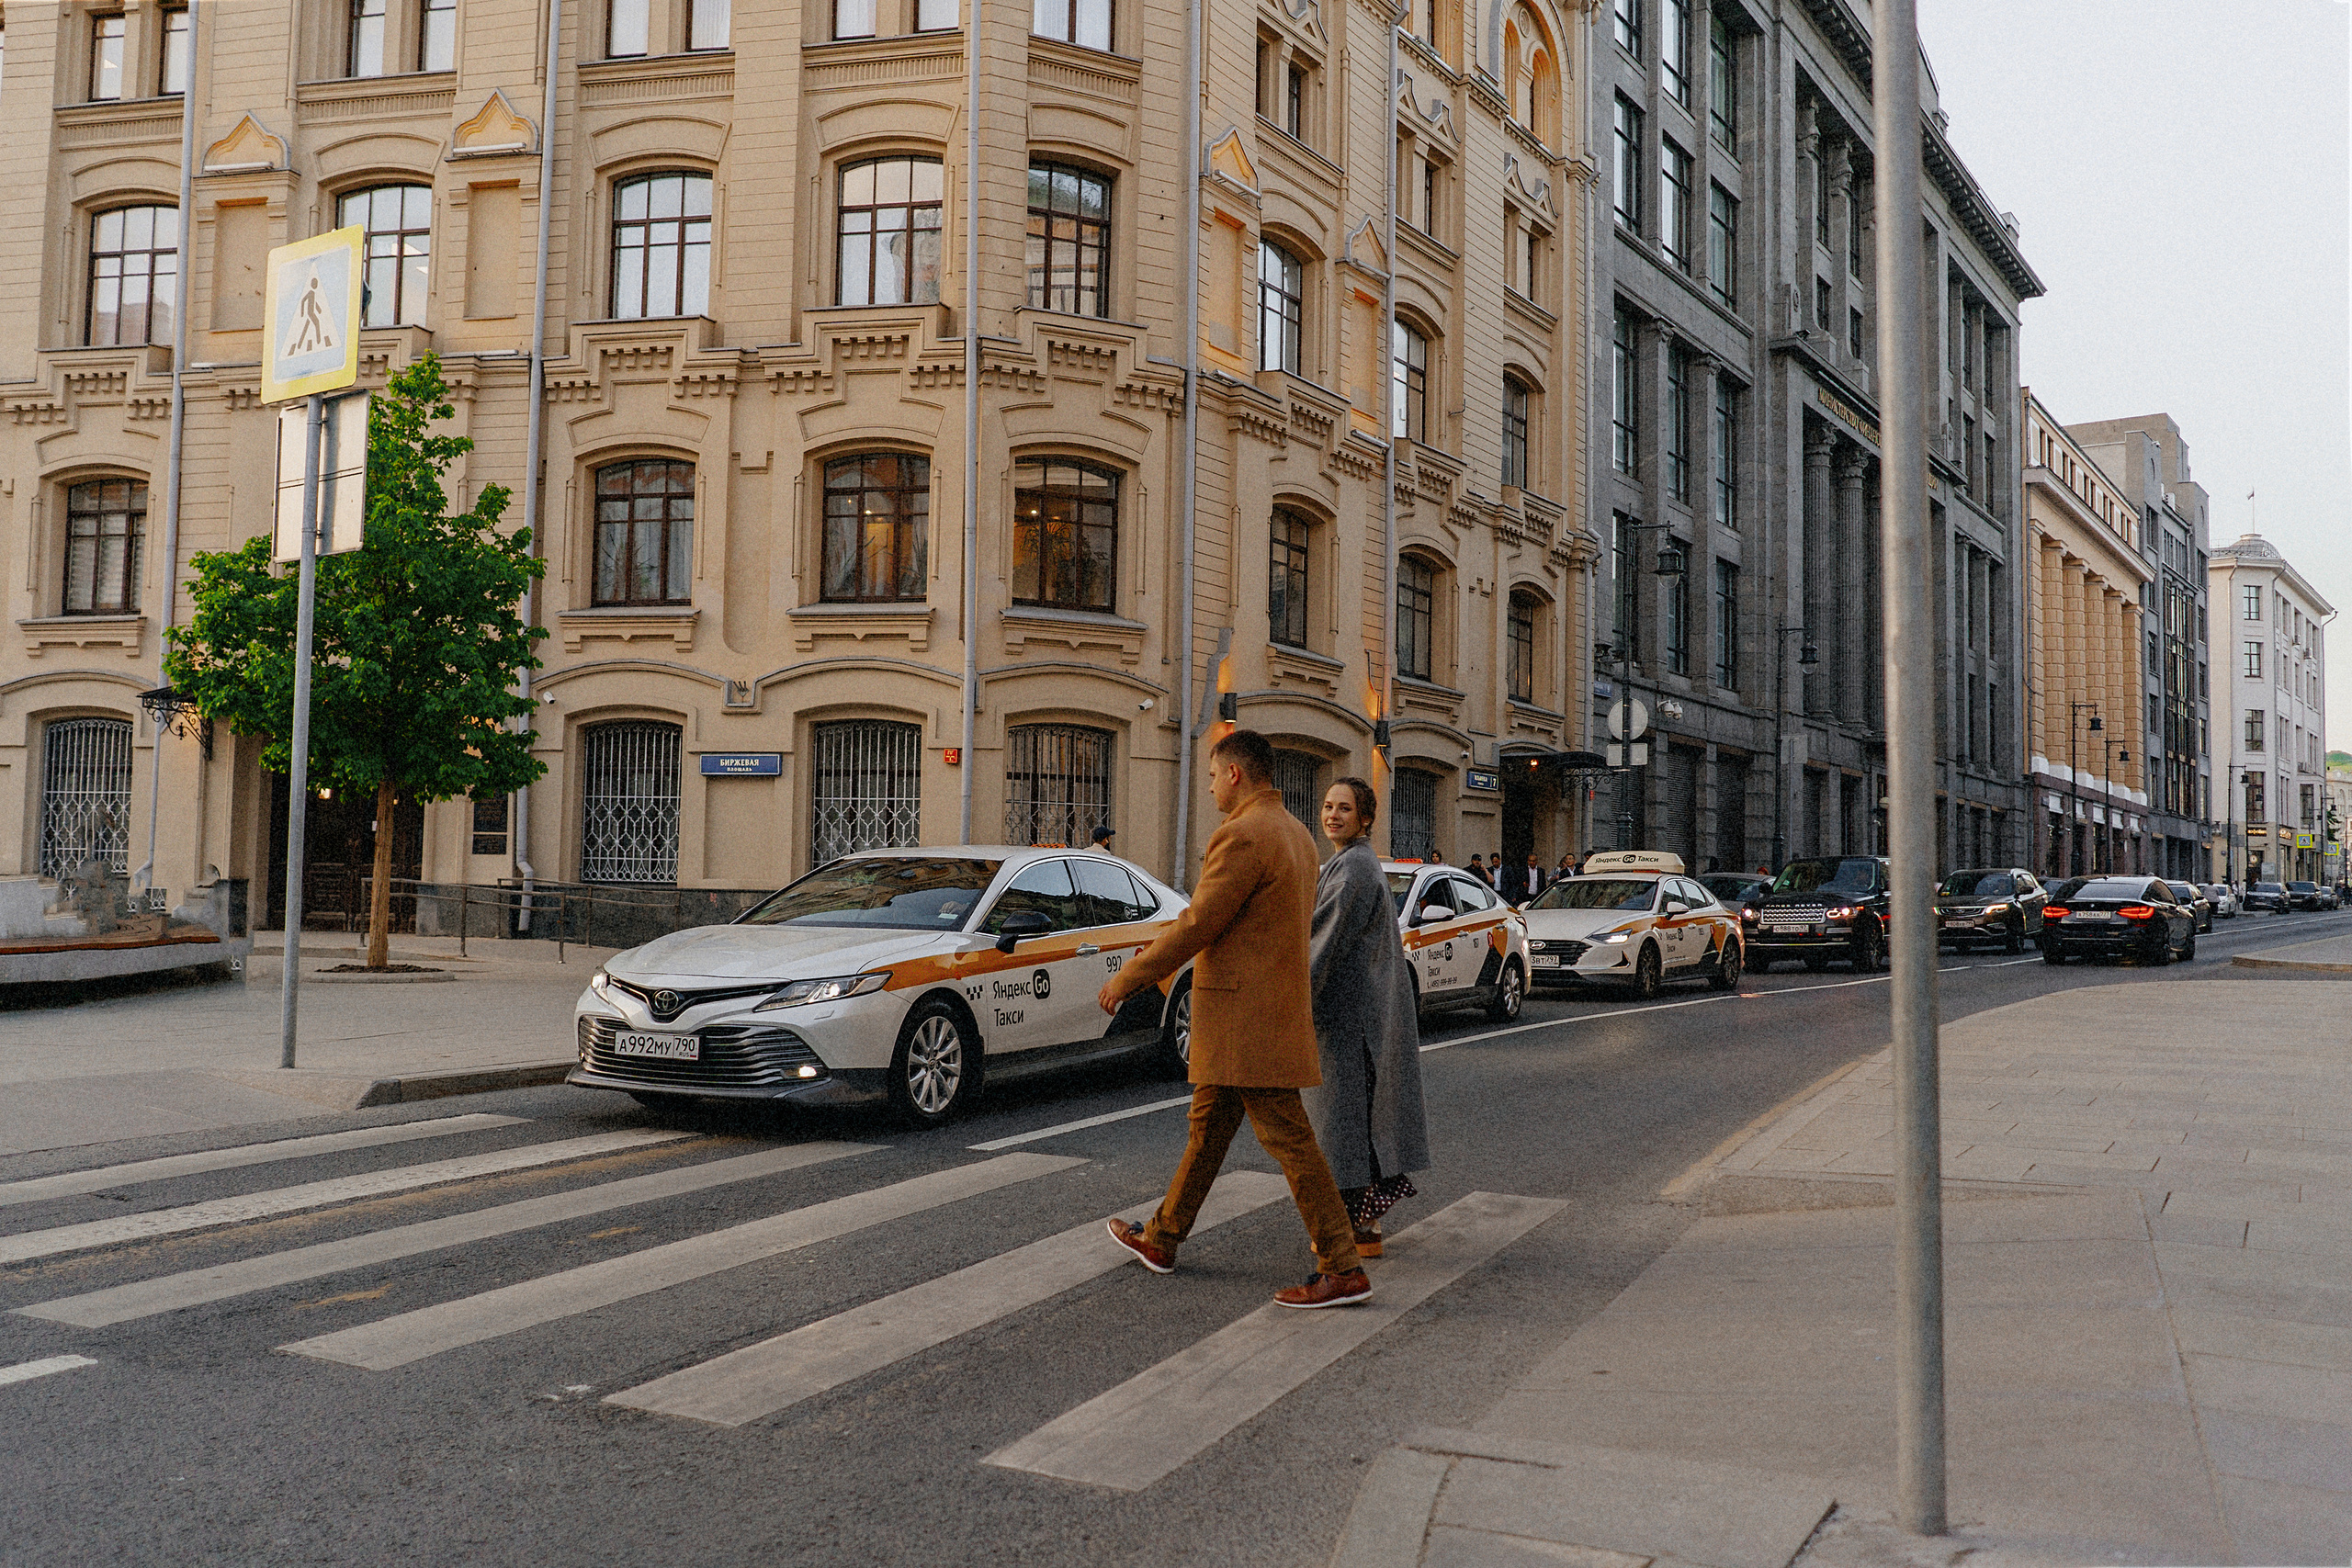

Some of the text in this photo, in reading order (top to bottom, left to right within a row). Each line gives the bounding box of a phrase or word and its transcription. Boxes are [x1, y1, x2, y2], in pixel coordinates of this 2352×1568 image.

[1819, 387, 1859, 430] МИНИСТЕРСТВО
[1427, 949, 1444, 960] Яндекс
[1427, 966, 1441, 977] Такси
[993, 974, 1049, 1000] Яндекс Go
[994, 1008, 1024, 1027] Такси
[619, 1035, 695, 1055] А992МУ 790
